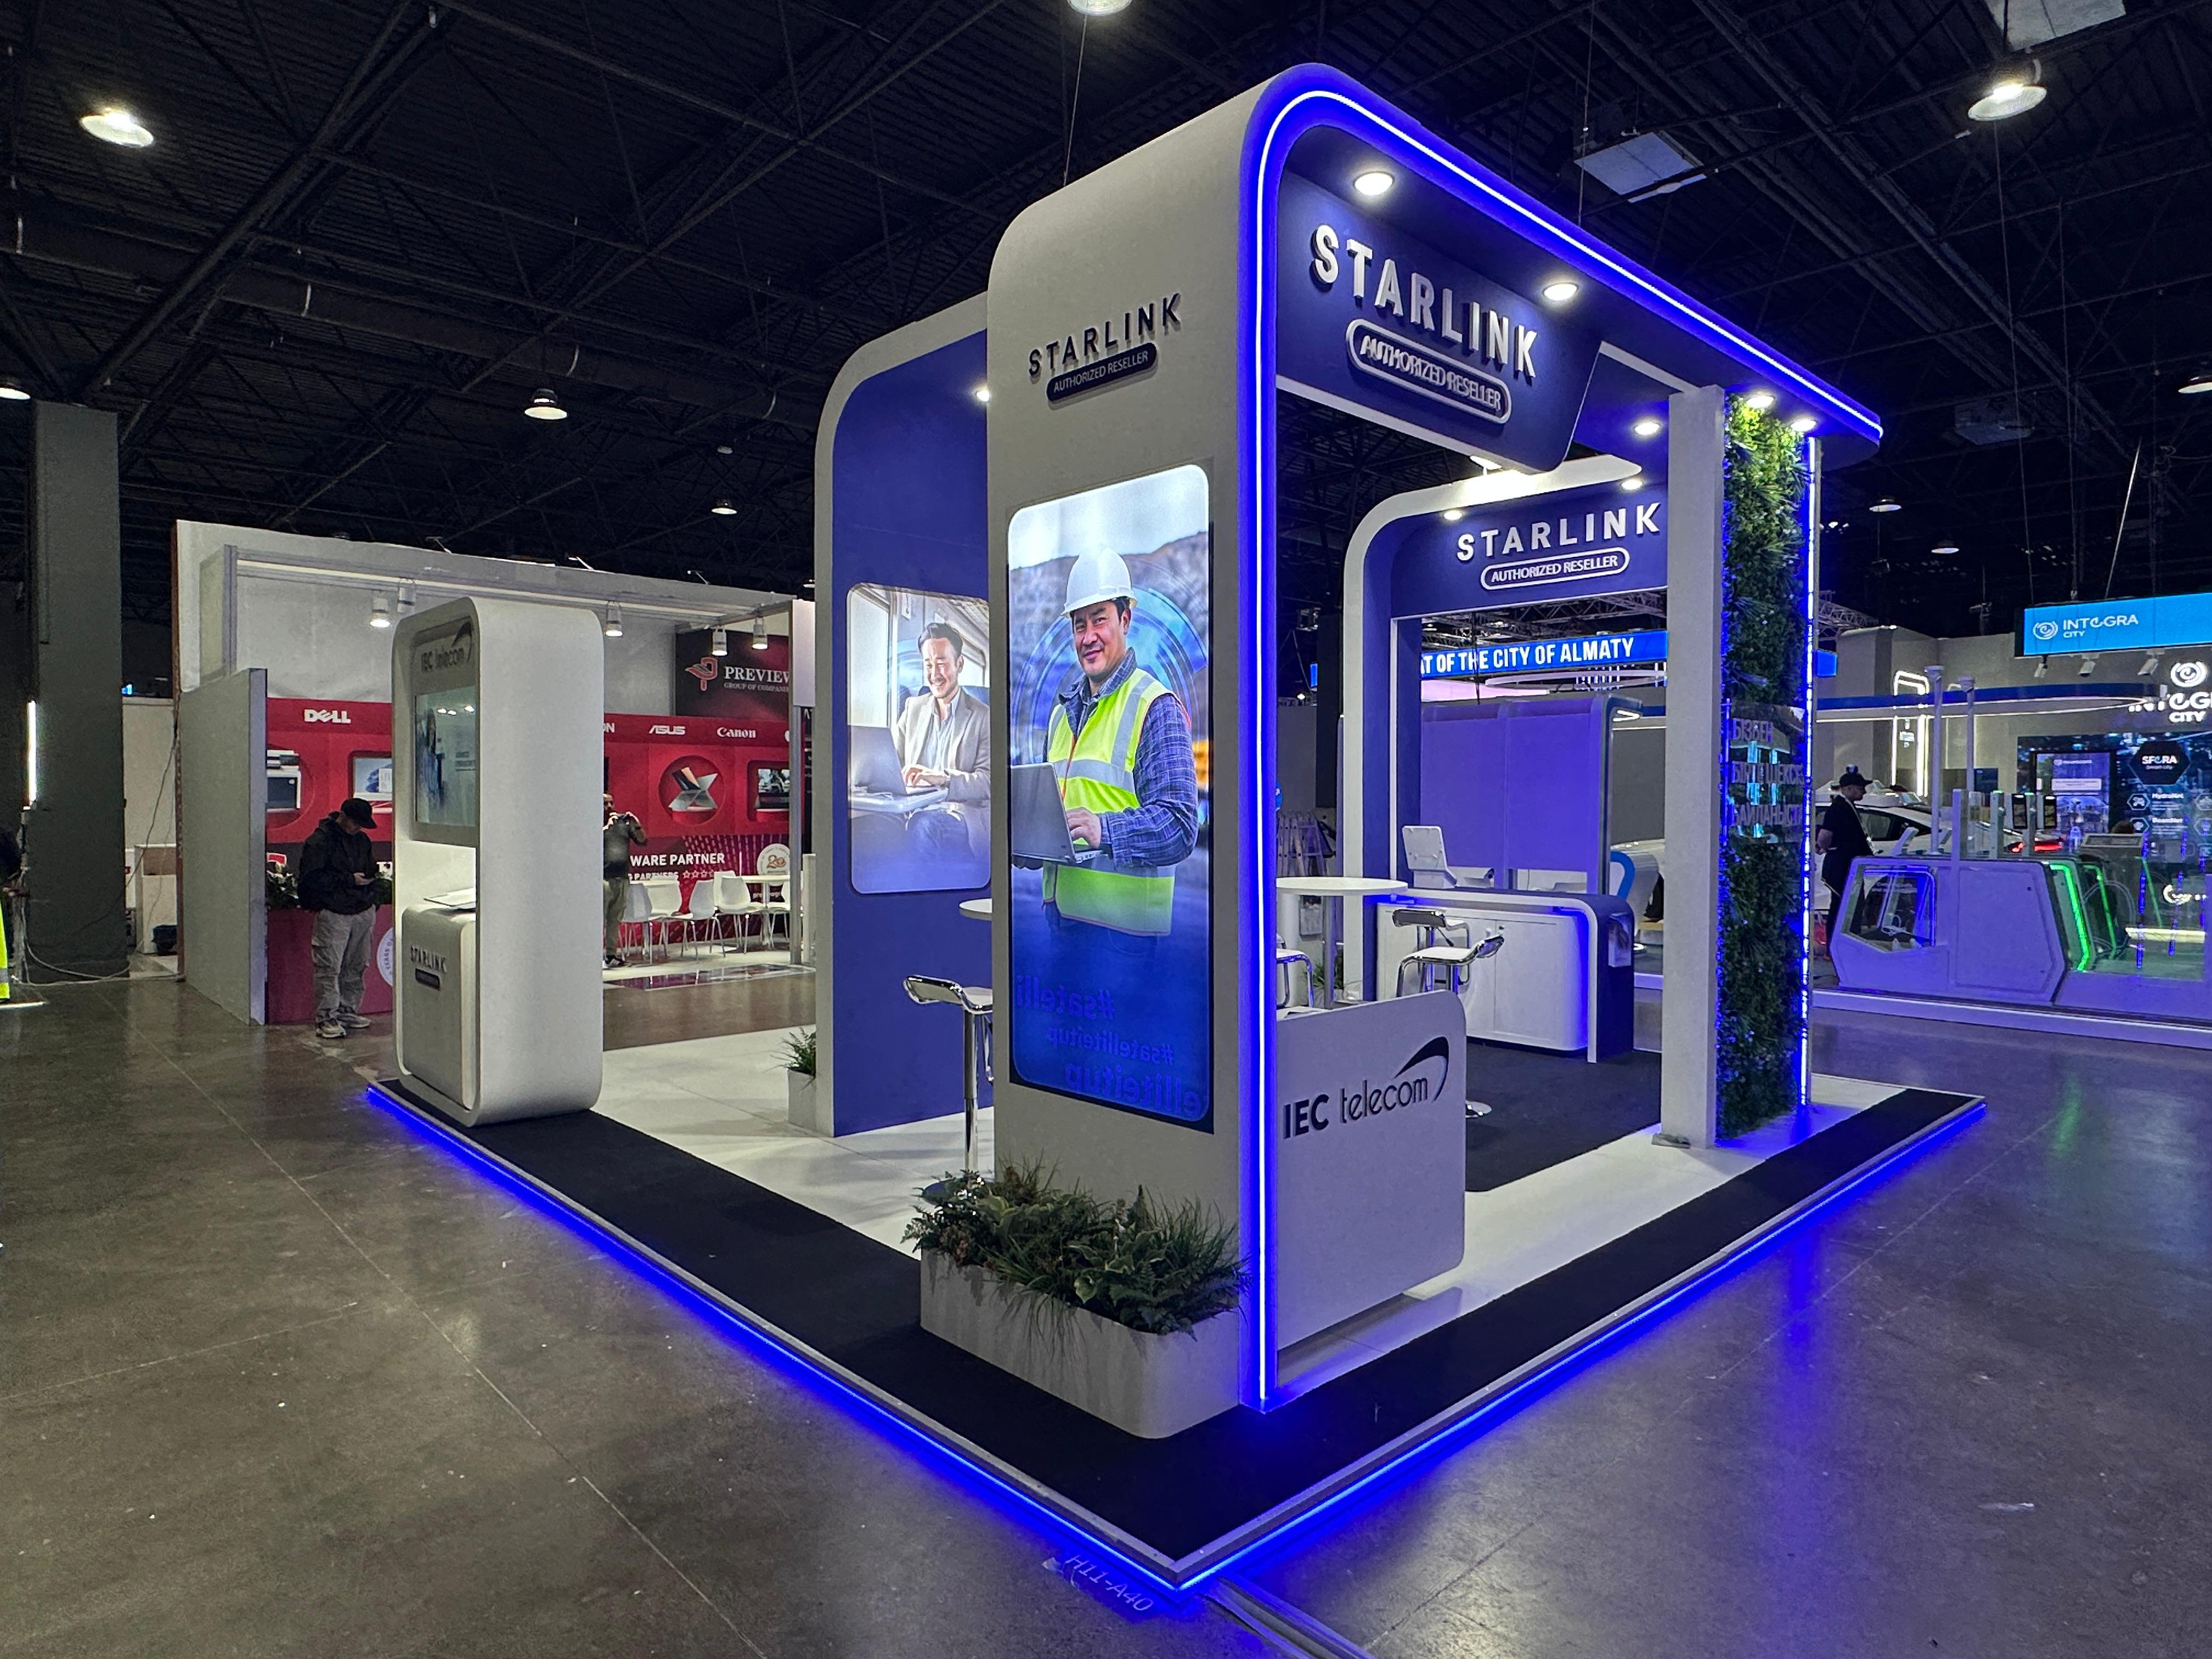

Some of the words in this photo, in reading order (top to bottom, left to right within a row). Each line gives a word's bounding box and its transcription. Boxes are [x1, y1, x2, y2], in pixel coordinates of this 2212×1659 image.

[1312, 224, 1537, 379] STARLINK
[1028, 292, 1181, 376] STARLINK
[1053, 365, 1106, 393] AUTHORIZED
[1107, 350, 1149, 375] RESELLER
[1359, 334, 1447, 387] AUTHORIZED
[1447, 370, 1502, 410] RESELLER
[1457, 503, 1661, 562] STARLINK
[1491, 563, 1562, 583] AUTHORIZED
[1563, 555, 1619, 573] RESELLER
[2063, 614, 2138, 630] INTEGRA
[1436, 653, 1455, 673] OF
[1457, 650, 1488, 672] THE
[1493, 646, 1531, 668] CITY
[1534, 644, 1556, 664] OF
[1560, 637, 1635, 663] ALMATY
[304, 709, 351, 724] DELL
[648, 725, 686, 735] ASUS
[716, 727, 756, 738] Canon
[2168, 711, 2207, 723] CITY
[630, 854, 667, 867] WARE
[669, 853, 725, 866] PARTNER
[1283, 1094, 1330, 1139] IEC
[1340, 1077, 1428, 1124] telecom
